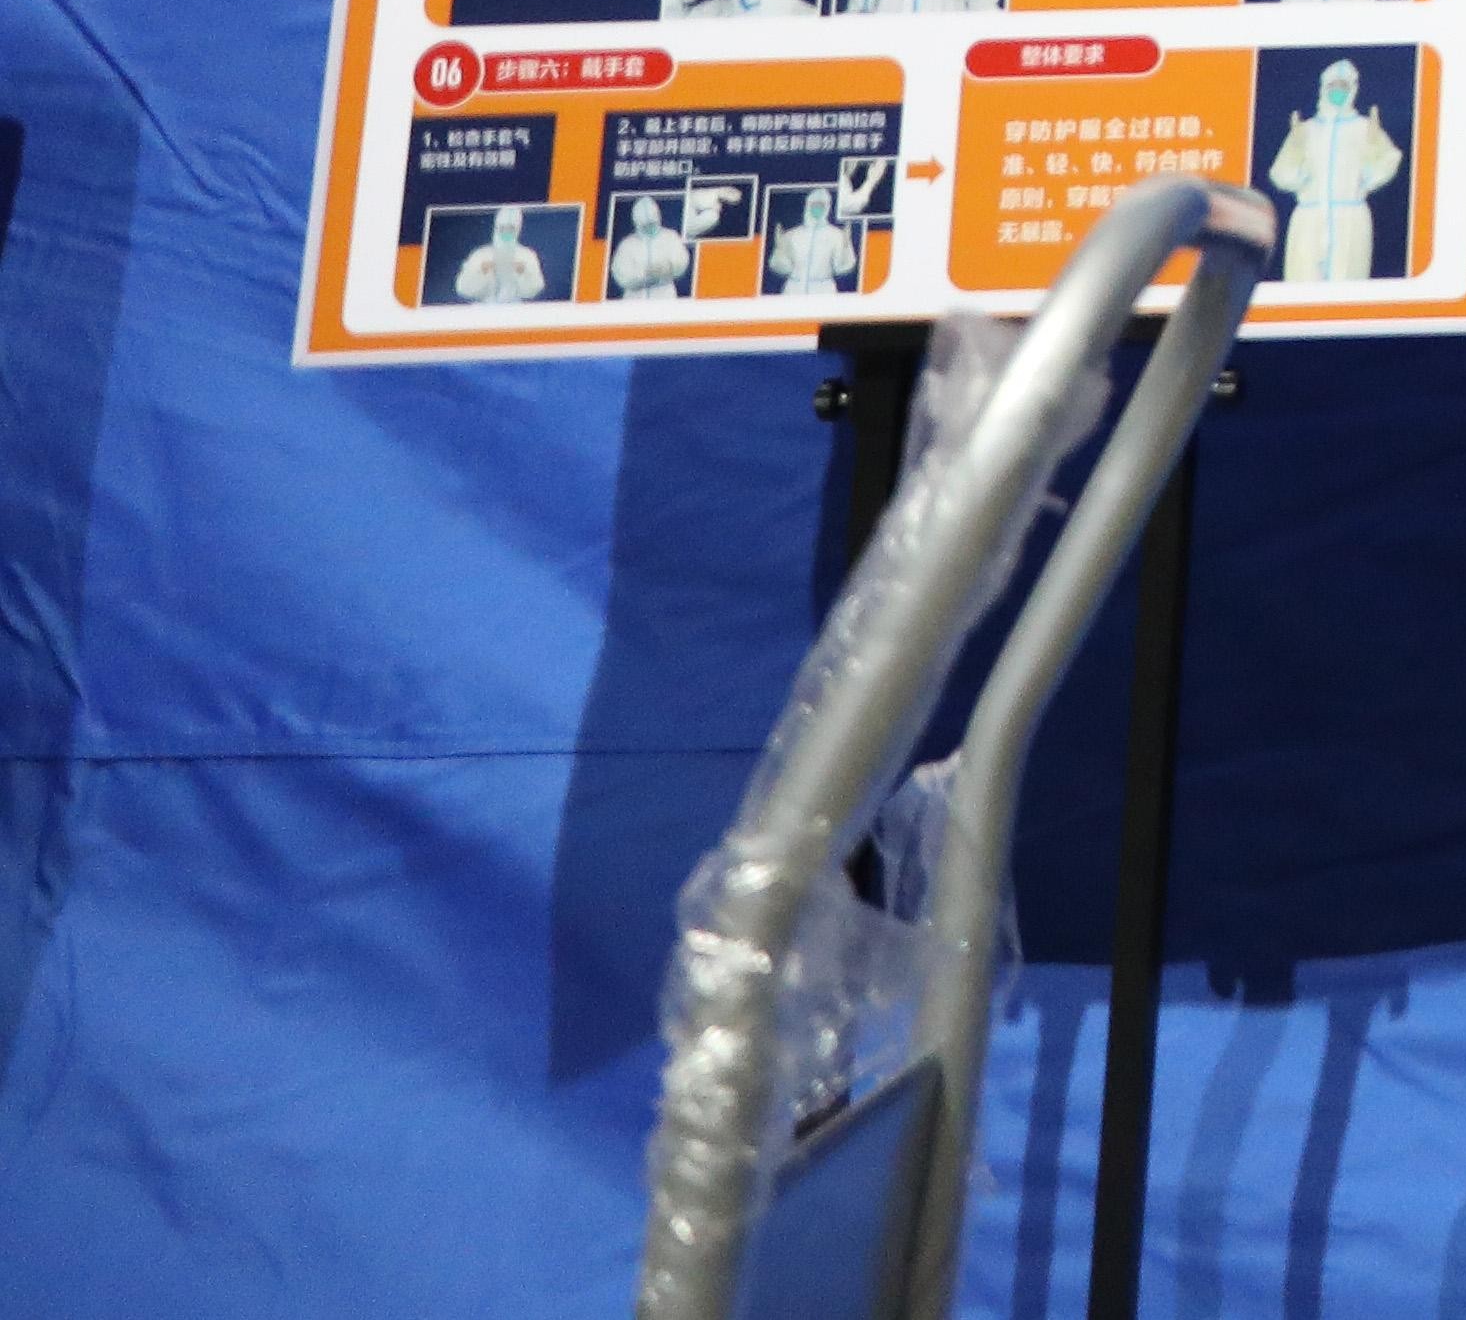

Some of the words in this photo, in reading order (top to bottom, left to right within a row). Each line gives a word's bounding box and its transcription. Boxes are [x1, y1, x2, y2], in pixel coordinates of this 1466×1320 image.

[1021, 45, 1105, 67] 整体要求
[431, 58, 462, 88] 06
[496, 55, 645, 80] 步骤六：戴手套
